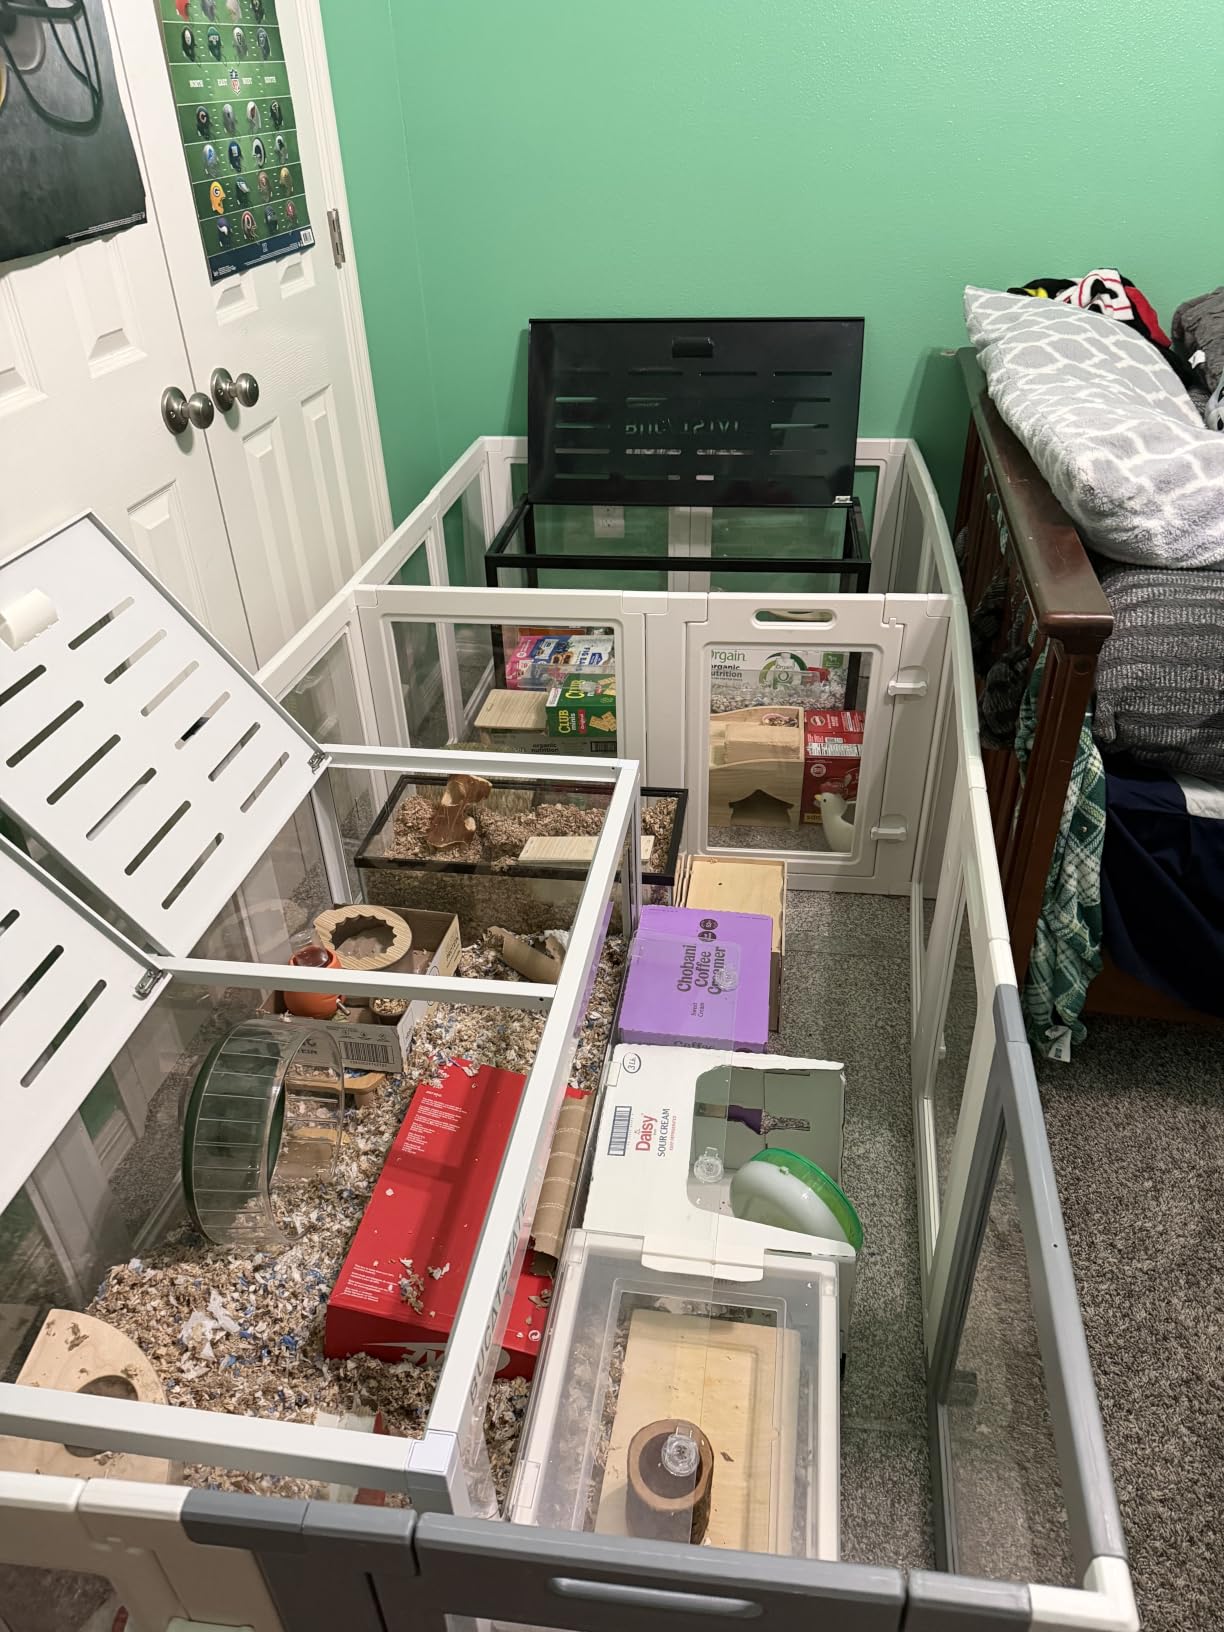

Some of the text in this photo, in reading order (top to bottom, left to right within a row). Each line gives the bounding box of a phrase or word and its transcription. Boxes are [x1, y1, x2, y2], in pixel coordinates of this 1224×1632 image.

[711, 650, 745, 662] rgain
[711, 670, 743, 678] utrition
[559, 709, 571, 733] CLUB
[677, 944, 696, 992] Chobani
[694, 951, 711, 988] Coffee
[635, 1115, 658, 1151] Daisy
[657, 1108, 671, 1157] SOUR CREAM
